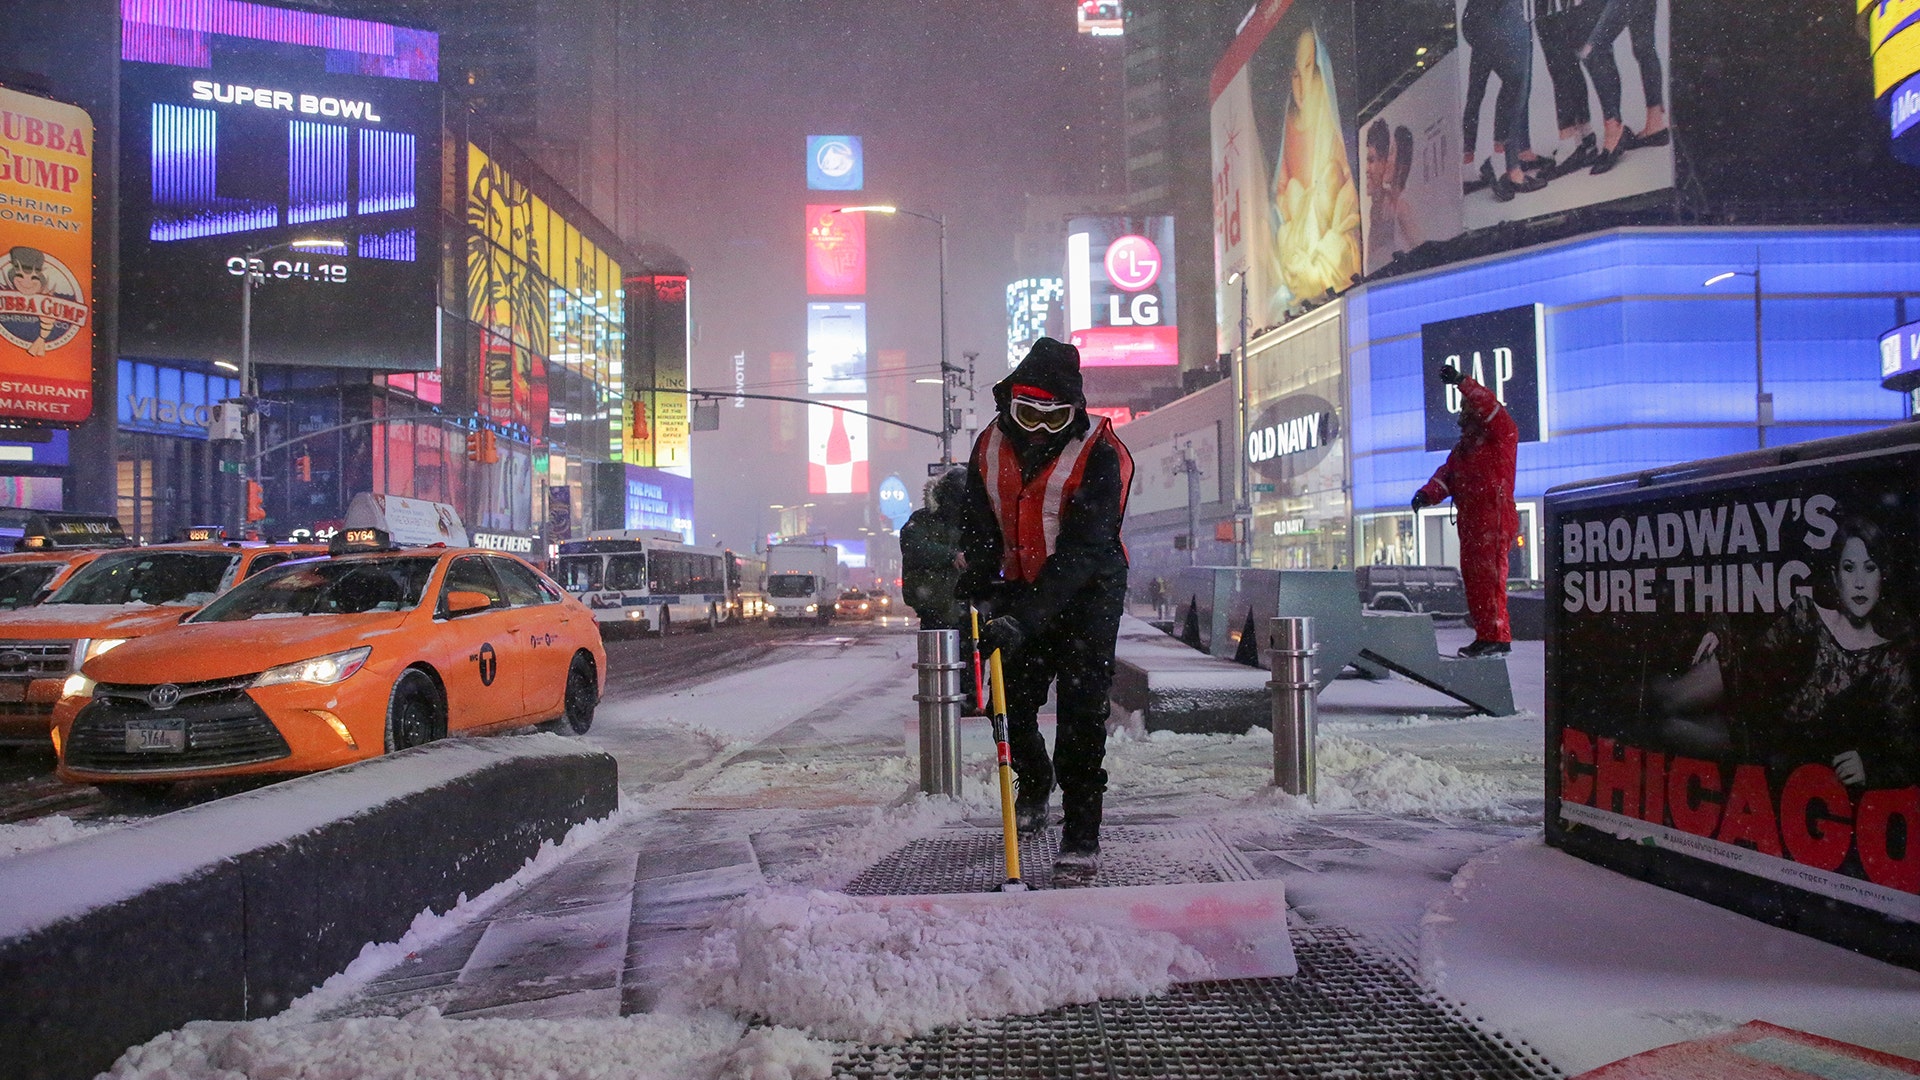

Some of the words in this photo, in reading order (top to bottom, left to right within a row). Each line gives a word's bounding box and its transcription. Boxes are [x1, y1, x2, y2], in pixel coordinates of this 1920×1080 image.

[193, 80, 294, 112] SUPER
[300, 94, 381, 122] BOWL
[0, 110, 87, 157] UBBA
[0, 193, 73, 215] SHRIMP
[0, 208, 82, 232] OMPANY
[41, 297, 86, 323] GUMP
[1109, 294, 1159, 326] LG
[735, 350, 745, 408] NOVOTEL
[1248, 427, 1276, 463] OLD
[1277, 412, 1320, 456] NAVY
[61, 523, 86, 534] NEW
[346, 531, 375, 542] 5Y64
[474, 532, 532, 552] SKECHERS
[1273, 520, 1287, 535] OLD
[1286, 518, 1305, 534] NAVY
[1563, 494, 1839, 564] BROADWAY'S
[1563, 570, 1656, 613] SURE
[1667, 560, 1813, 613] THING
[1561, 727, 1920, 896] CHICAGO
